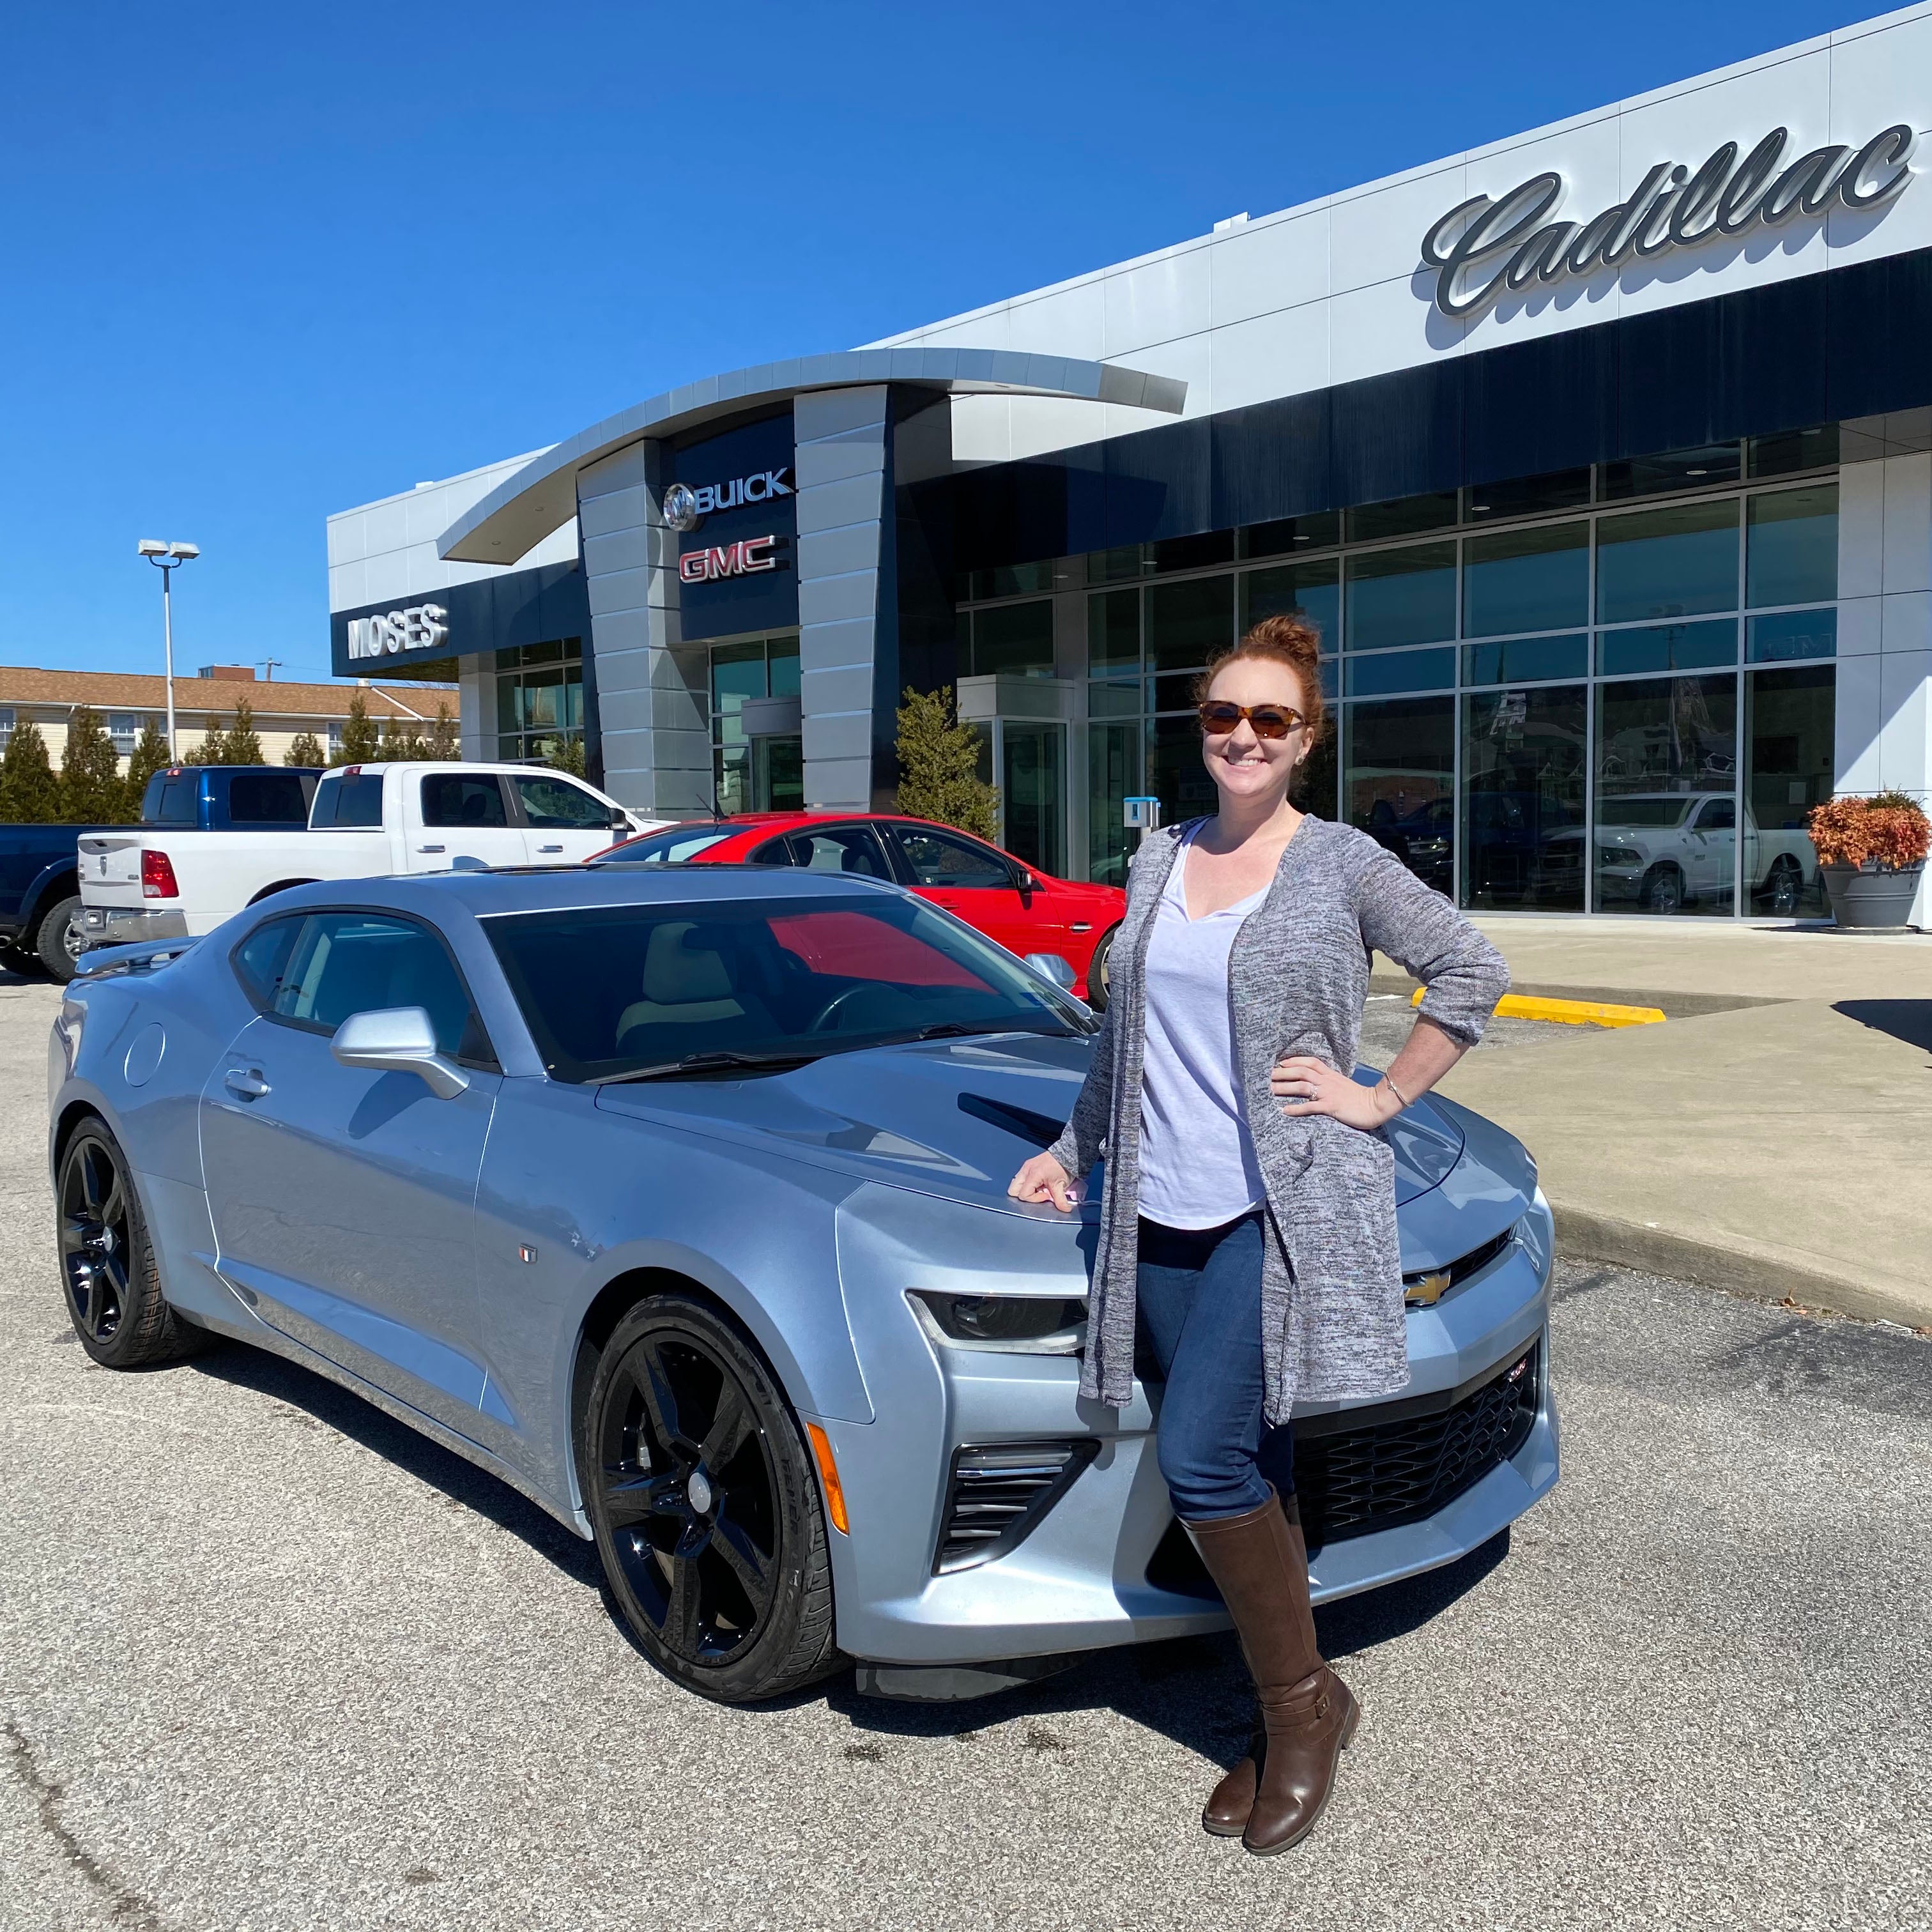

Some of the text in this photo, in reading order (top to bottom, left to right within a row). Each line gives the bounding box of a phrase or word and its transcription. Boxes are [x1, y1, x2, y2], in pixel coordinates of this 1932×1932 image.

[1420, 124, 1914, 317] Cadillac
[694, 467, 791, 514] BUICK
[679, 535, 776, 583] GMC
[348, 603, 443, 659] MOSES
